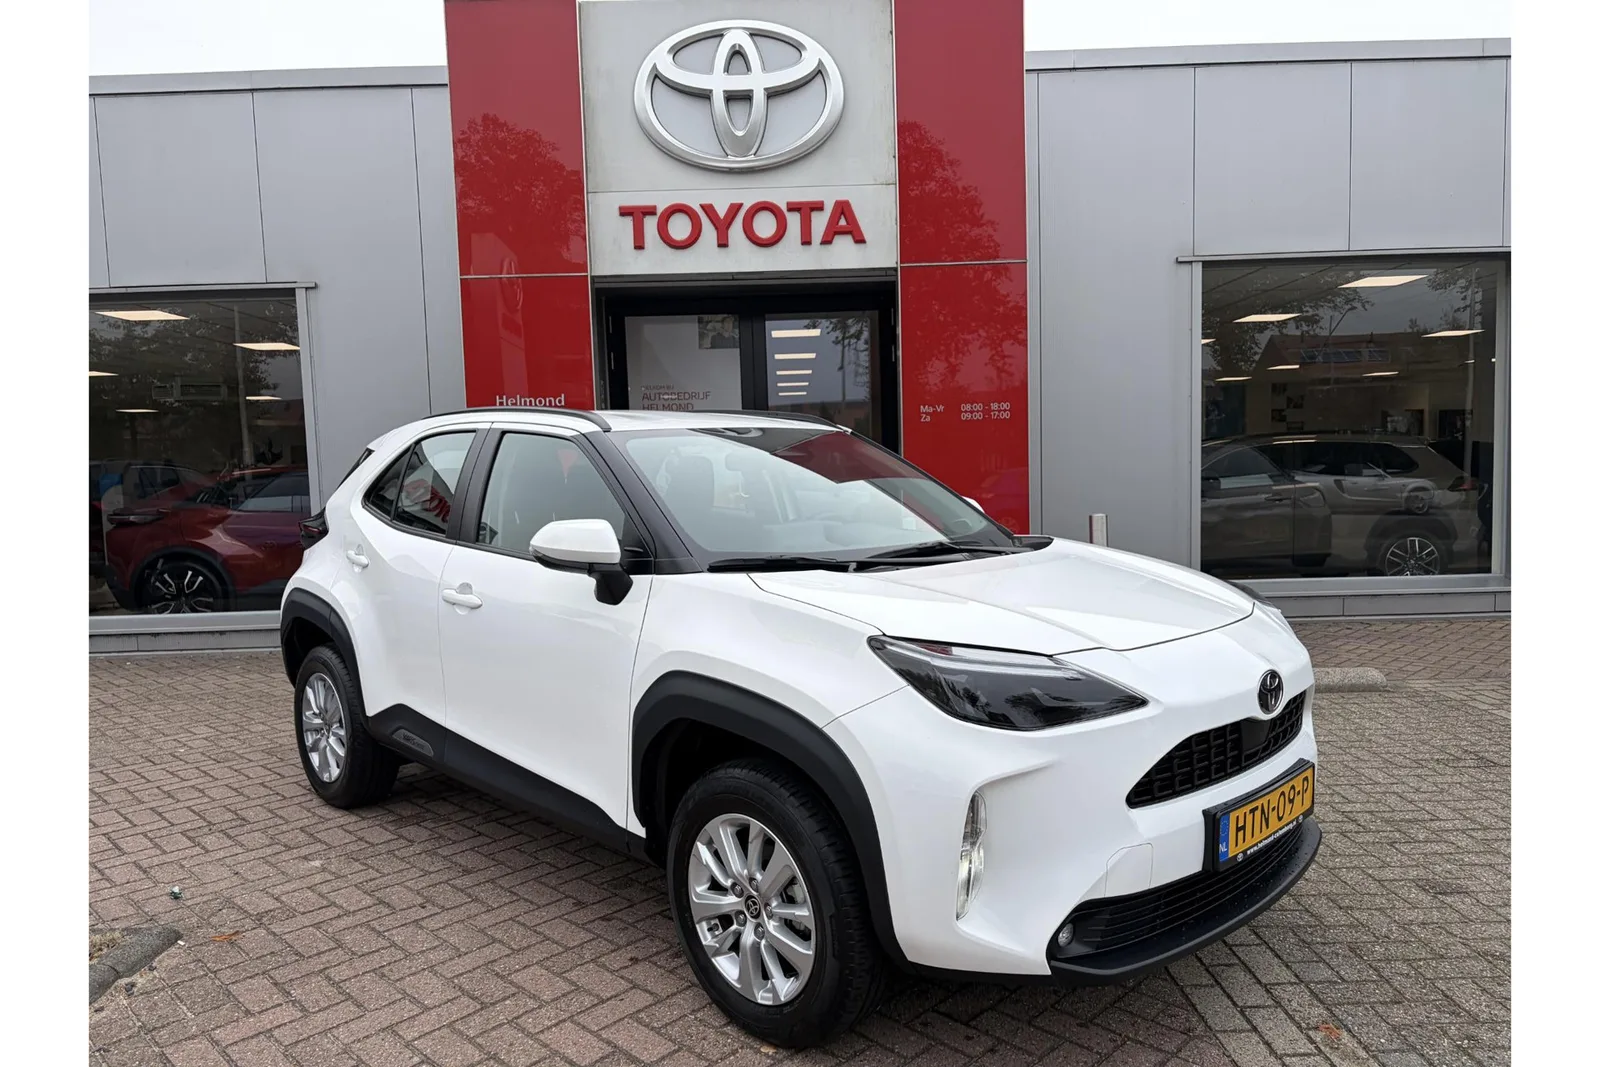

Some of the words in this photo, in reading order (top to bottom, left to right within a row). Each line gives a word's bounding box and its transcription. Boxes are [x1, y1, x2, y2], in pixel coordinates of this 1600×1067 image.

[618, 199, 867, 250] TOYOTA
[495, 393, 565, 407] Helmond
[642, 391, 711, 402] AUTOBEDRIJF
[642, 402, 694, 412] HELMOND
[920, 404, 945, 413] Ma-Vr
[960, 403, 983, 412] 08:00
[990, 402, 1011, 411] 18:00
[920, 413, 931, 422] Za
[960, 412, 983, 421] 09:00
[990, 411, 1011, 419] 17:00
[1219, 842, 1228, 853] NL
[1235, 776, 1309, 848] HTN-09-P
